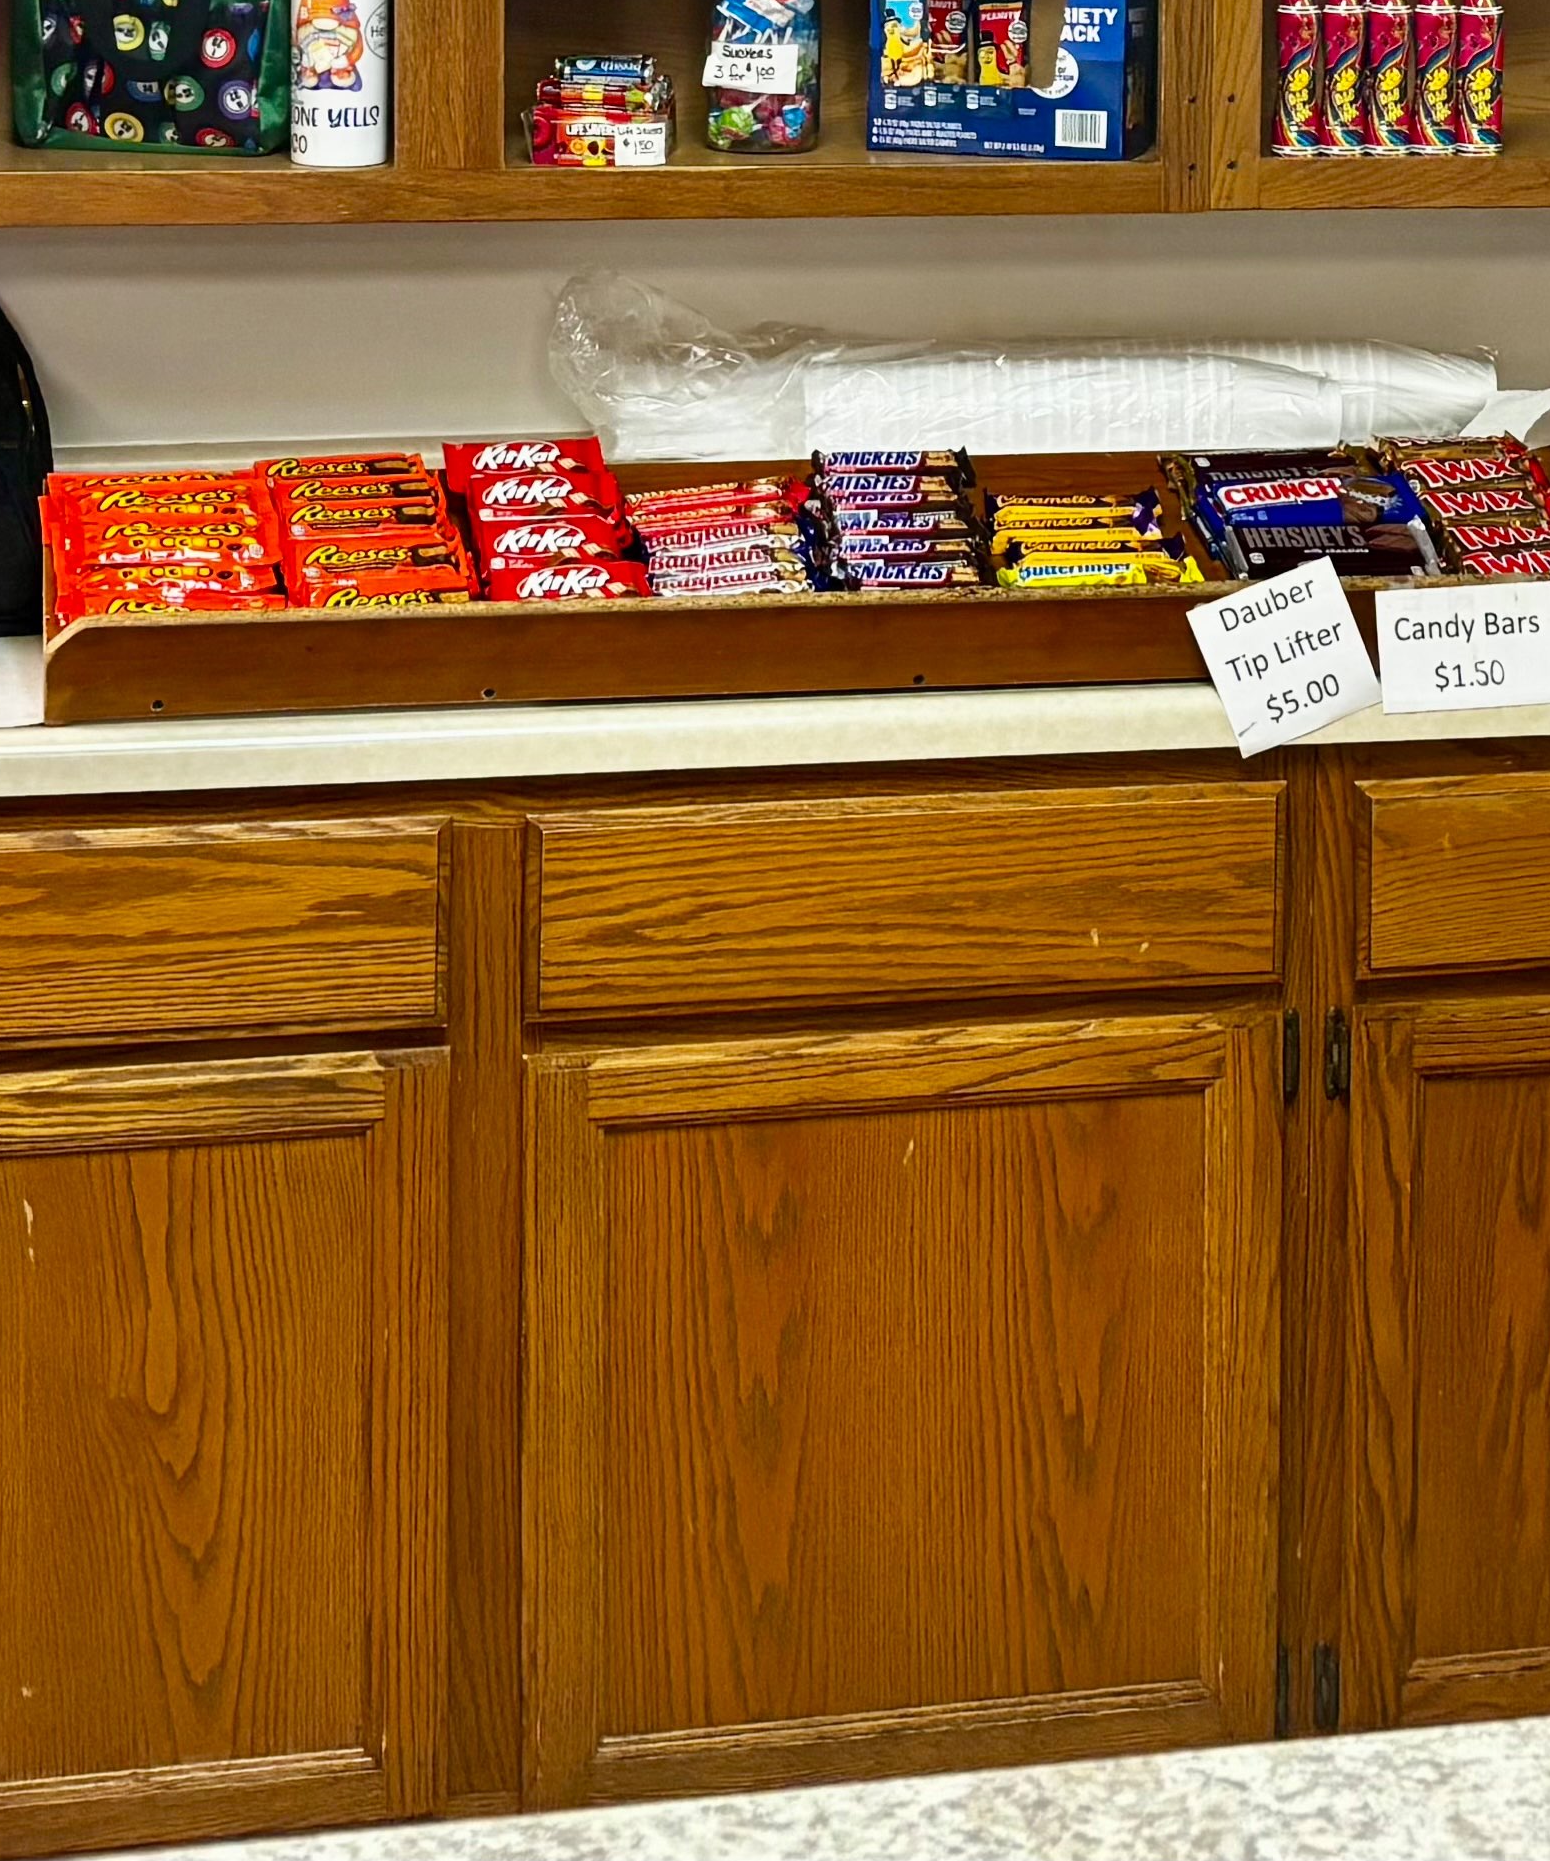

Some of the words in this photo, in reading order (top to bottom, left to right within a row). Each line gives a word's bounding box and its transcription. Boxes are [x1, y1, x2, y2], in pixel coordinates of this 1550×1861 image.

[714, 65, 724, 79] 3
[327, 105, 379, 128] YELLS
[828, 451, 920, 467] SNICKERS
[831, 475, 915, 490] ATISFIES
[1224, 478, 1340, 506] CRUNCH
[996, 494, 1097, 508] Caramello
[994, 517, 1093, 531] Caramello
[843, 539, 929, 553] NICKERS
[1021, 540, 1122, 555] Caramello
[1242, 526, 1368, 549] HERSHEY'S
[850, 562, 946, 581] SNICKERS
[1219, 579, 1314, 632] Dauber
[1394, 612, 1475, 643] Candy
[1484, 611, 1540, 636] Bars
[1225, 653, 1269, 682] Tip
[1273, 622, 1342, 664] Lifter
[1434, 659, 1505, 692] $1.50
[1266, 673, 1340, 723] $5.00
